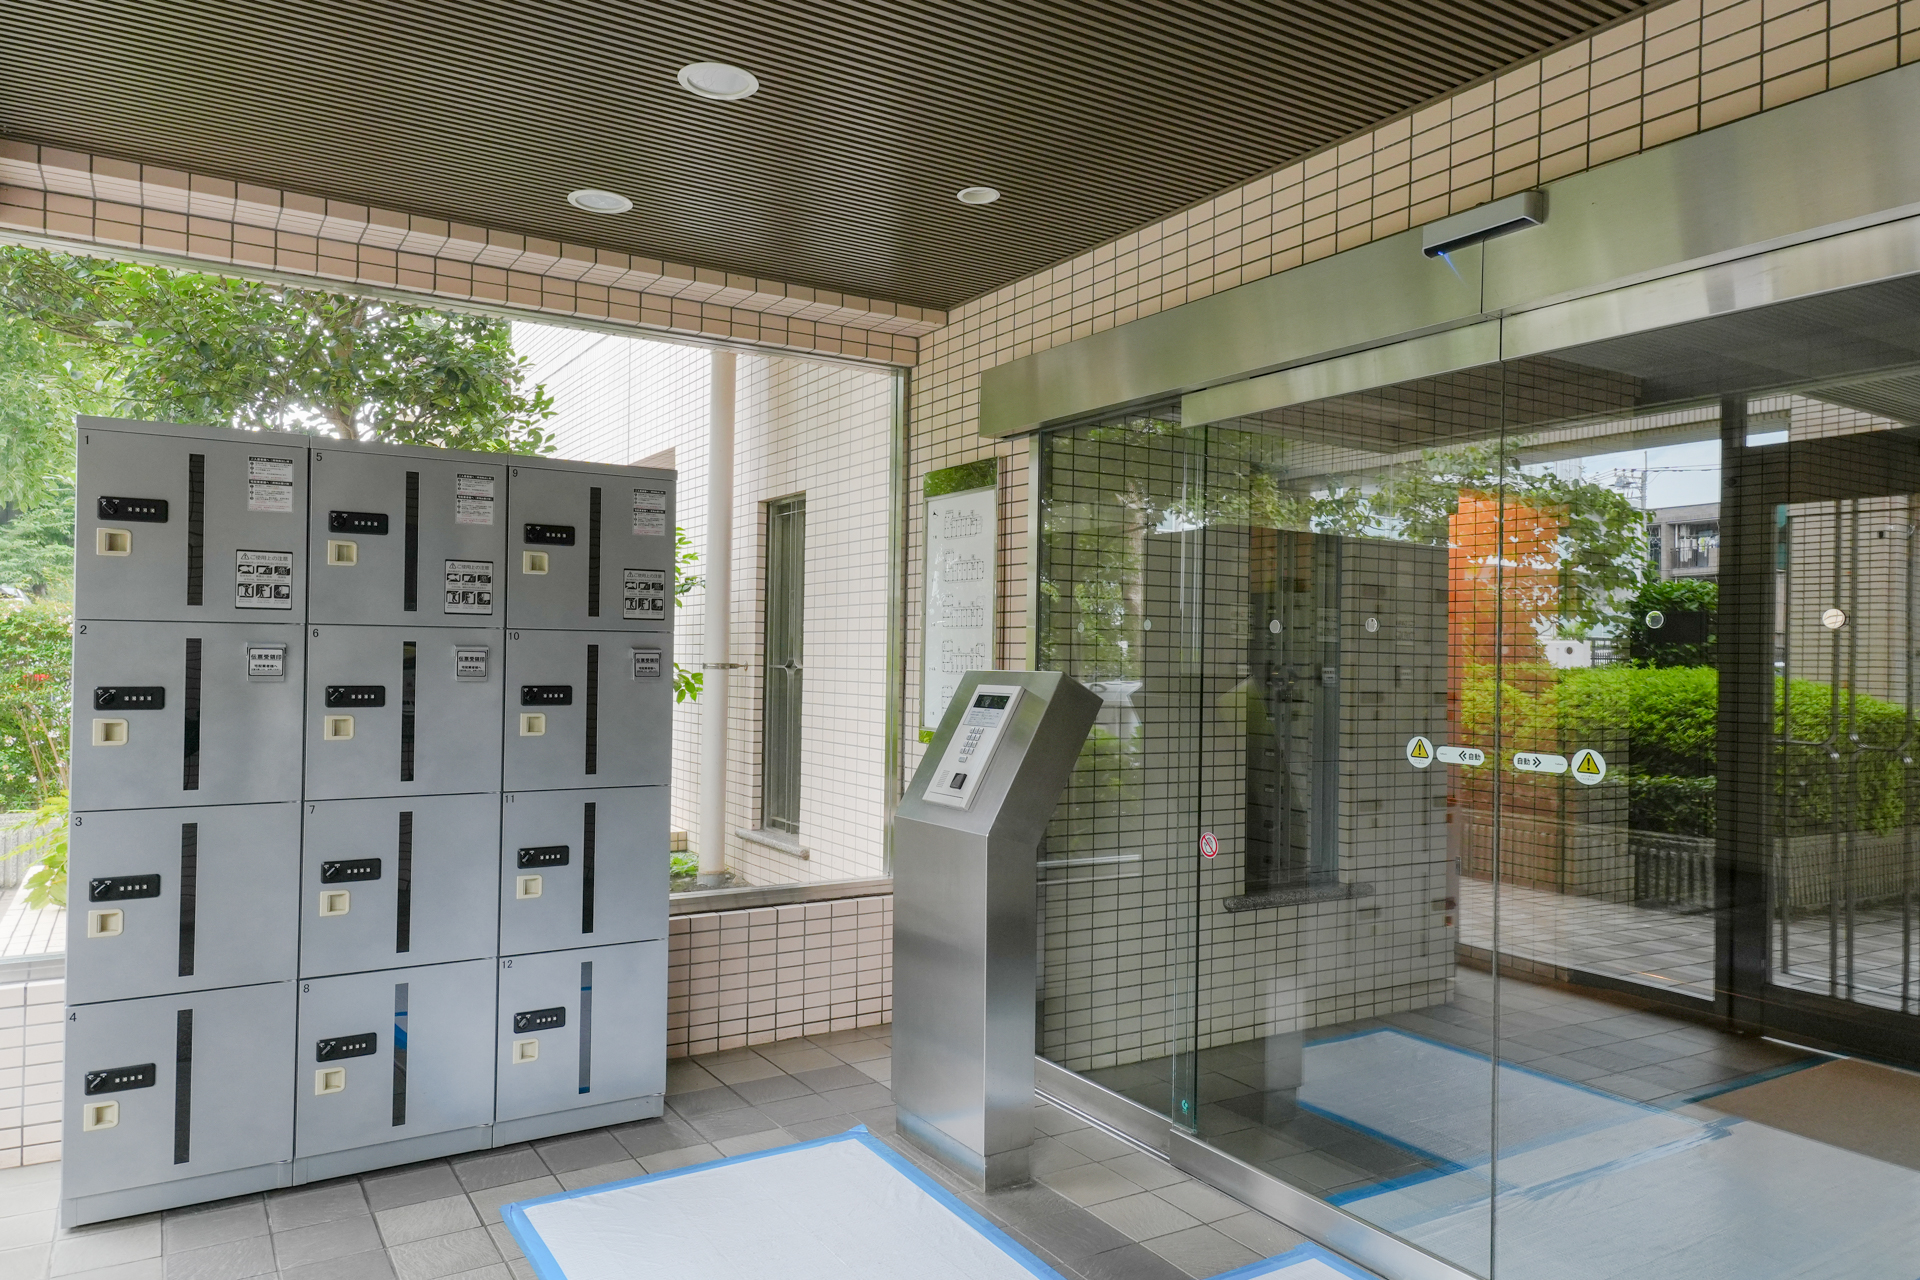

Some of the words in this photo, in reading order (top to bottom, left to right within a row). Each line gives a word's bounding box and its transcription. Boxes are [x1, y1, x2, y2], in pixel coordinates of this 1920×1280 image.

[316, 452, 323, 462] 5
[512, 469, 519, 478] 9
[79, 624, 88, 635] 2
[312, 628, 319, 638] 6
[508, 632, 520, 641] 10
[1468, 753, 1482, 761] 自動
[1517, 757, 1531, 766] 自動
[504, 795, 515, 804] 11
[309, 805, 316, 815] 7
[74, 816, 83, 827] 3
[502, 960, 514, 969] 12
[303, 984, 310, 994] 8
[69, 1012, 77, 1022] 4
